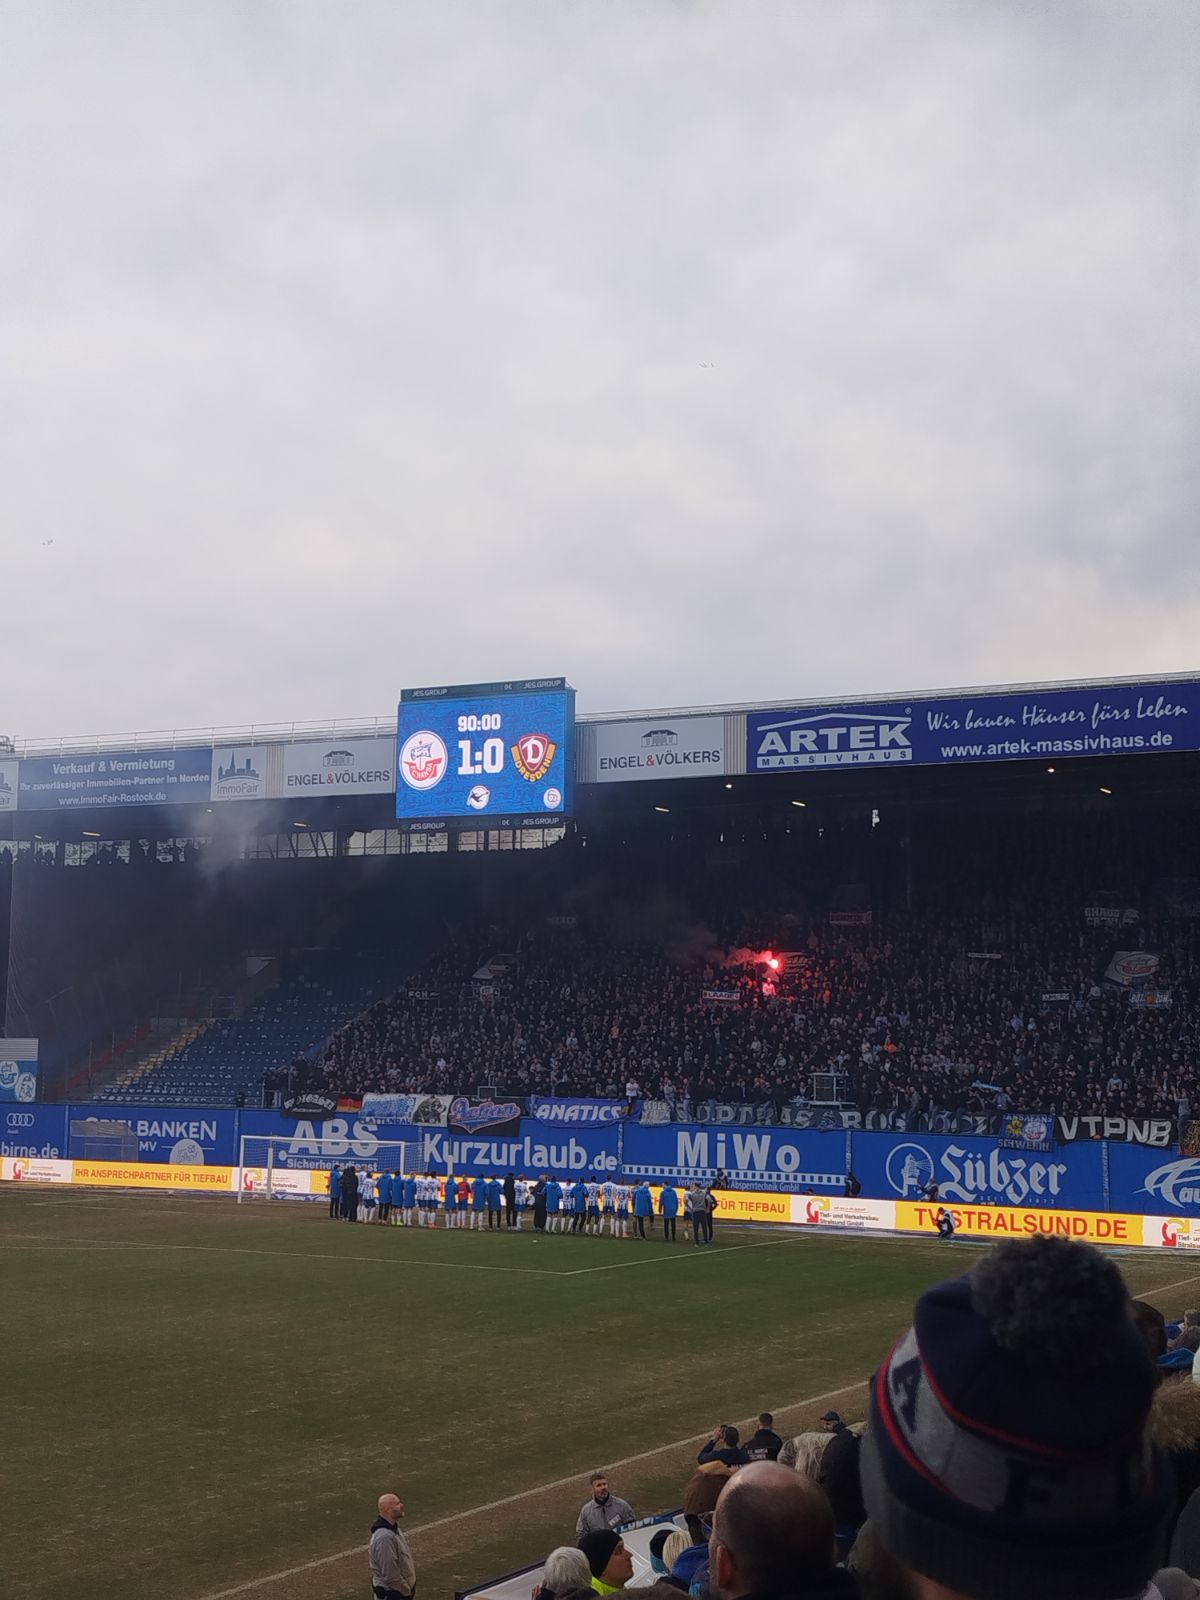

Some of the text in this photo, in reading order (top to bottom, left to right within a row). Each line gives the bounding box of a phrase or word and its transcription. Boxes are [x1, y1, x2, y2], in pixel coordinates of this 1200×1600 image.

[458, 713, 502, 732] 90:00
[927, 696, 1188, 731] Wir bauen Häuser fürs Leben
[757, 722, 912, 754] ARTEK
[941, 731, 1173, 758] www.artek-massivhaus.de
[52, 757, 175, 775] Verkauf & Vermietung
[458, 738, 504, 775] 1:0
[761, 751, 907, 767] MASSIVHAUS
[515, 758, 552, 783] DRESDEN
[20, 773, 210, 792] Ihr zuverlässiger Immobilien-Partner im Norden
[217, 783, 259, 795] ImmoFair
[58, 791, 167, 805] www.ImmoFair-Rostock.de
[288, 1118, 379, 1156] ABS
[1057, 1116, 1172, 1147] VTPNB
[1, 1142, 59, 1159] birne.de
[139, 1141, 157, 1152] MV
[424, 1133, 618, 1171] Kurzurlaub.de
[677, 1131, 800, 1172] MiWo
[75, 1168, 228, 1184] IHR ANSPRECHPARTNER FÜR TIEFBAU
[730, 1181, 778, 1192] Absperrtechnik
[780, 1183, 800, 1193] GmbH
[738, 1200, 785, 1215] TIEFBAU
